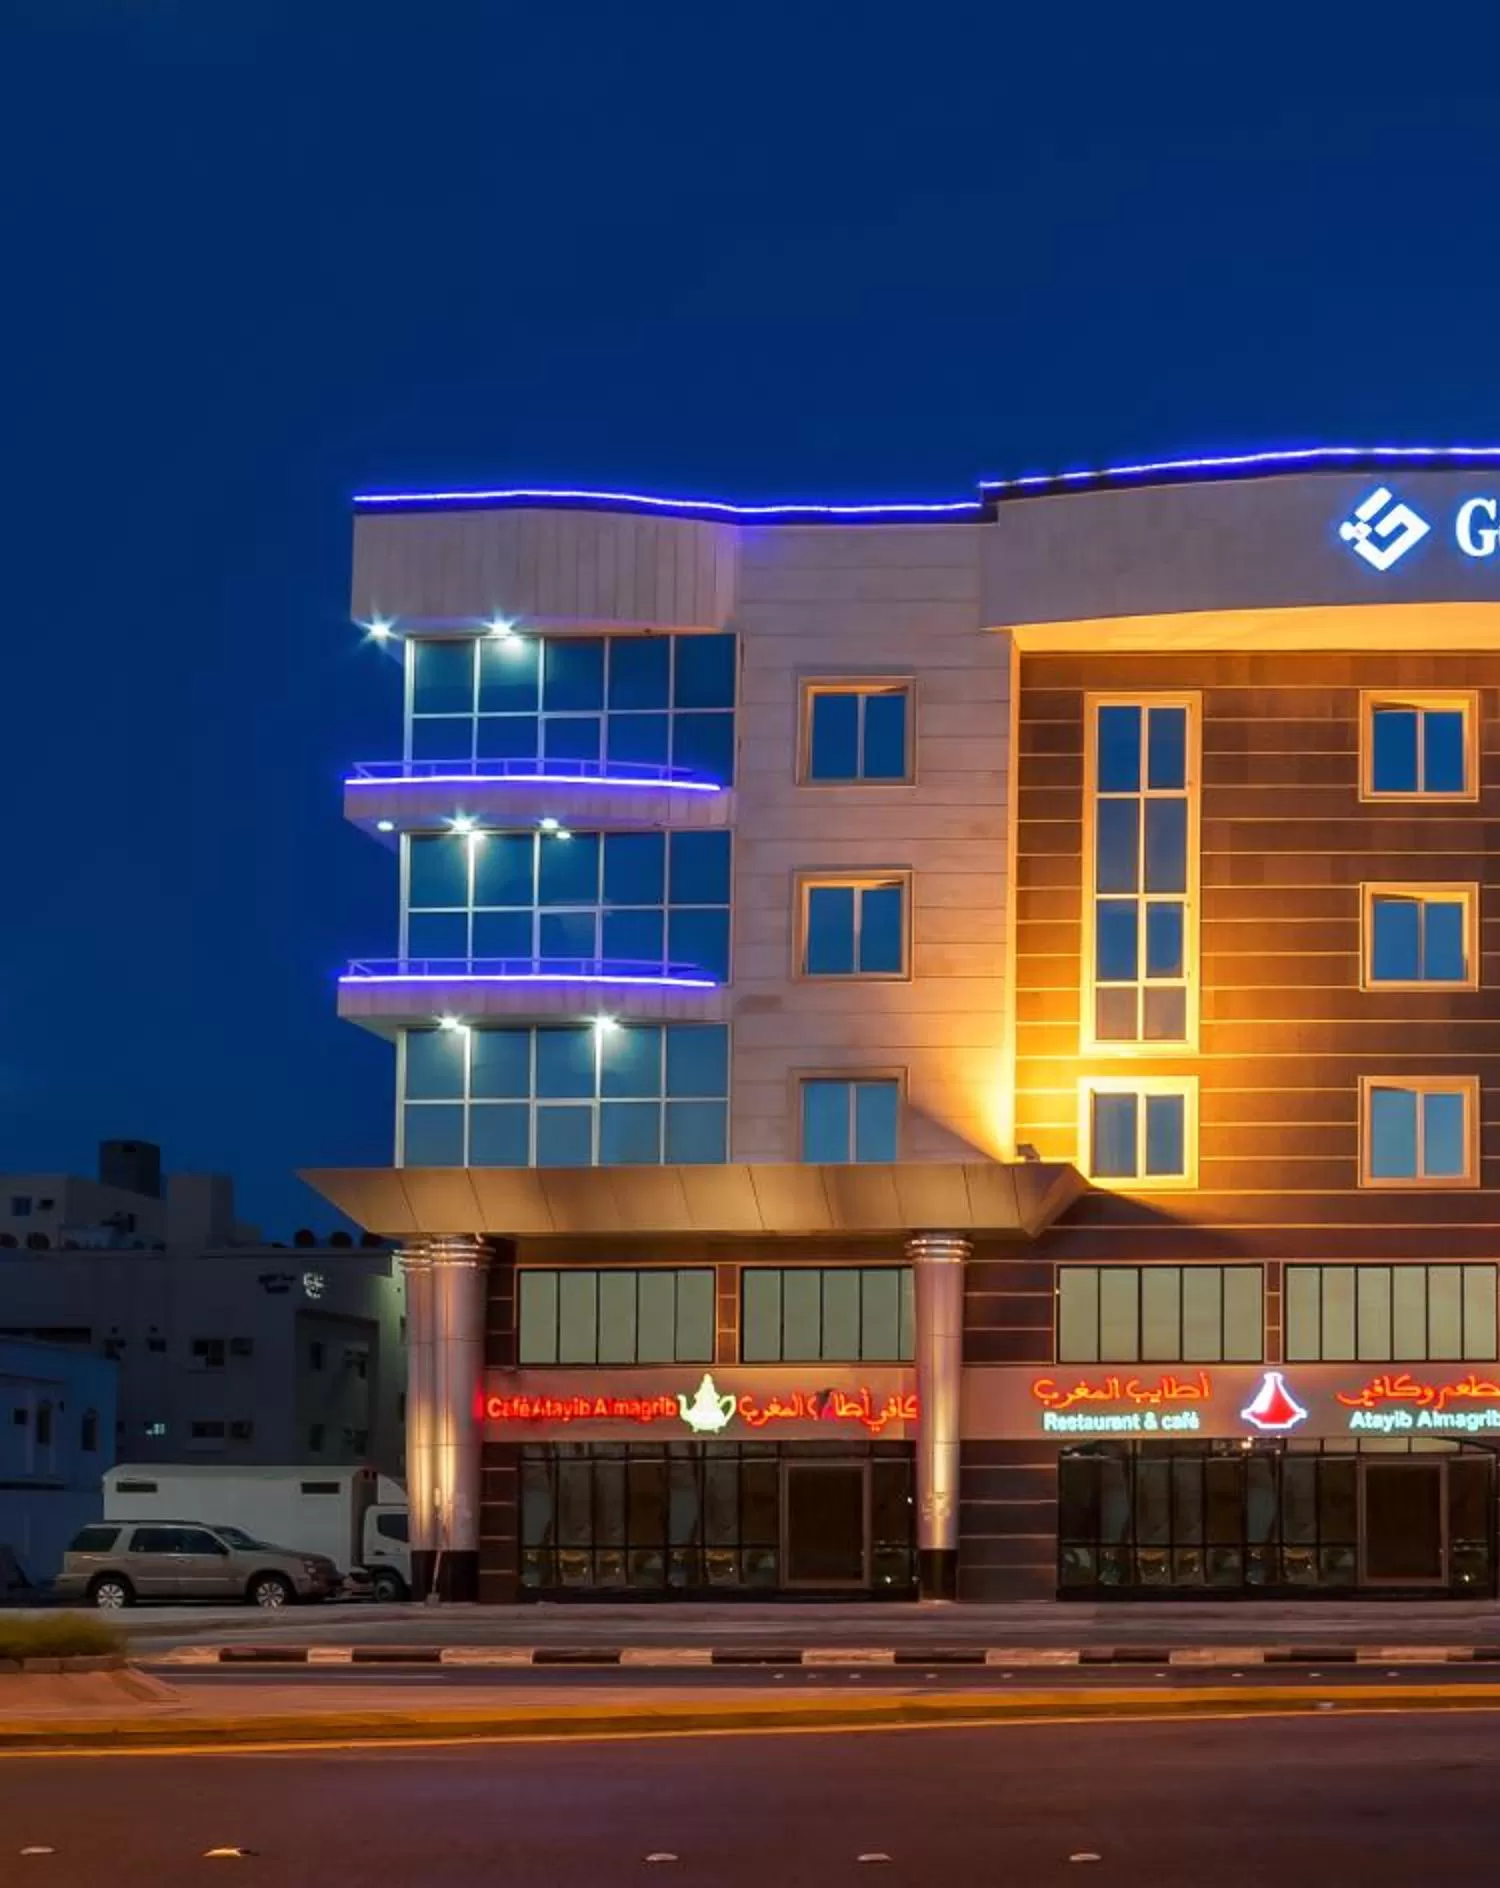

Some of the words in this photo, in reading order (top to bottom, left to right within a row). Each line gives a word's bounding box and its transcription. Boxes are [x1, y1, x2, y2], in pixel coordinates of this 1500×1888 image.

[806, 1386, 870, 1421] أطاب
[1033, 1376, 1121, 1409] المغرب
[1125, 1371, 1211, 1403] أطايب
[738, 1392, 804, 1426] المغرب
[862, 1395, 918, 1432] كافي
[1043, 1411, 1140, 1431] Restaurant
[1143, 1411, 1159, 1431] &
[1161, 1411, 1200, 1431] café
[1350, 1410, 1413, 1432] Atayib
